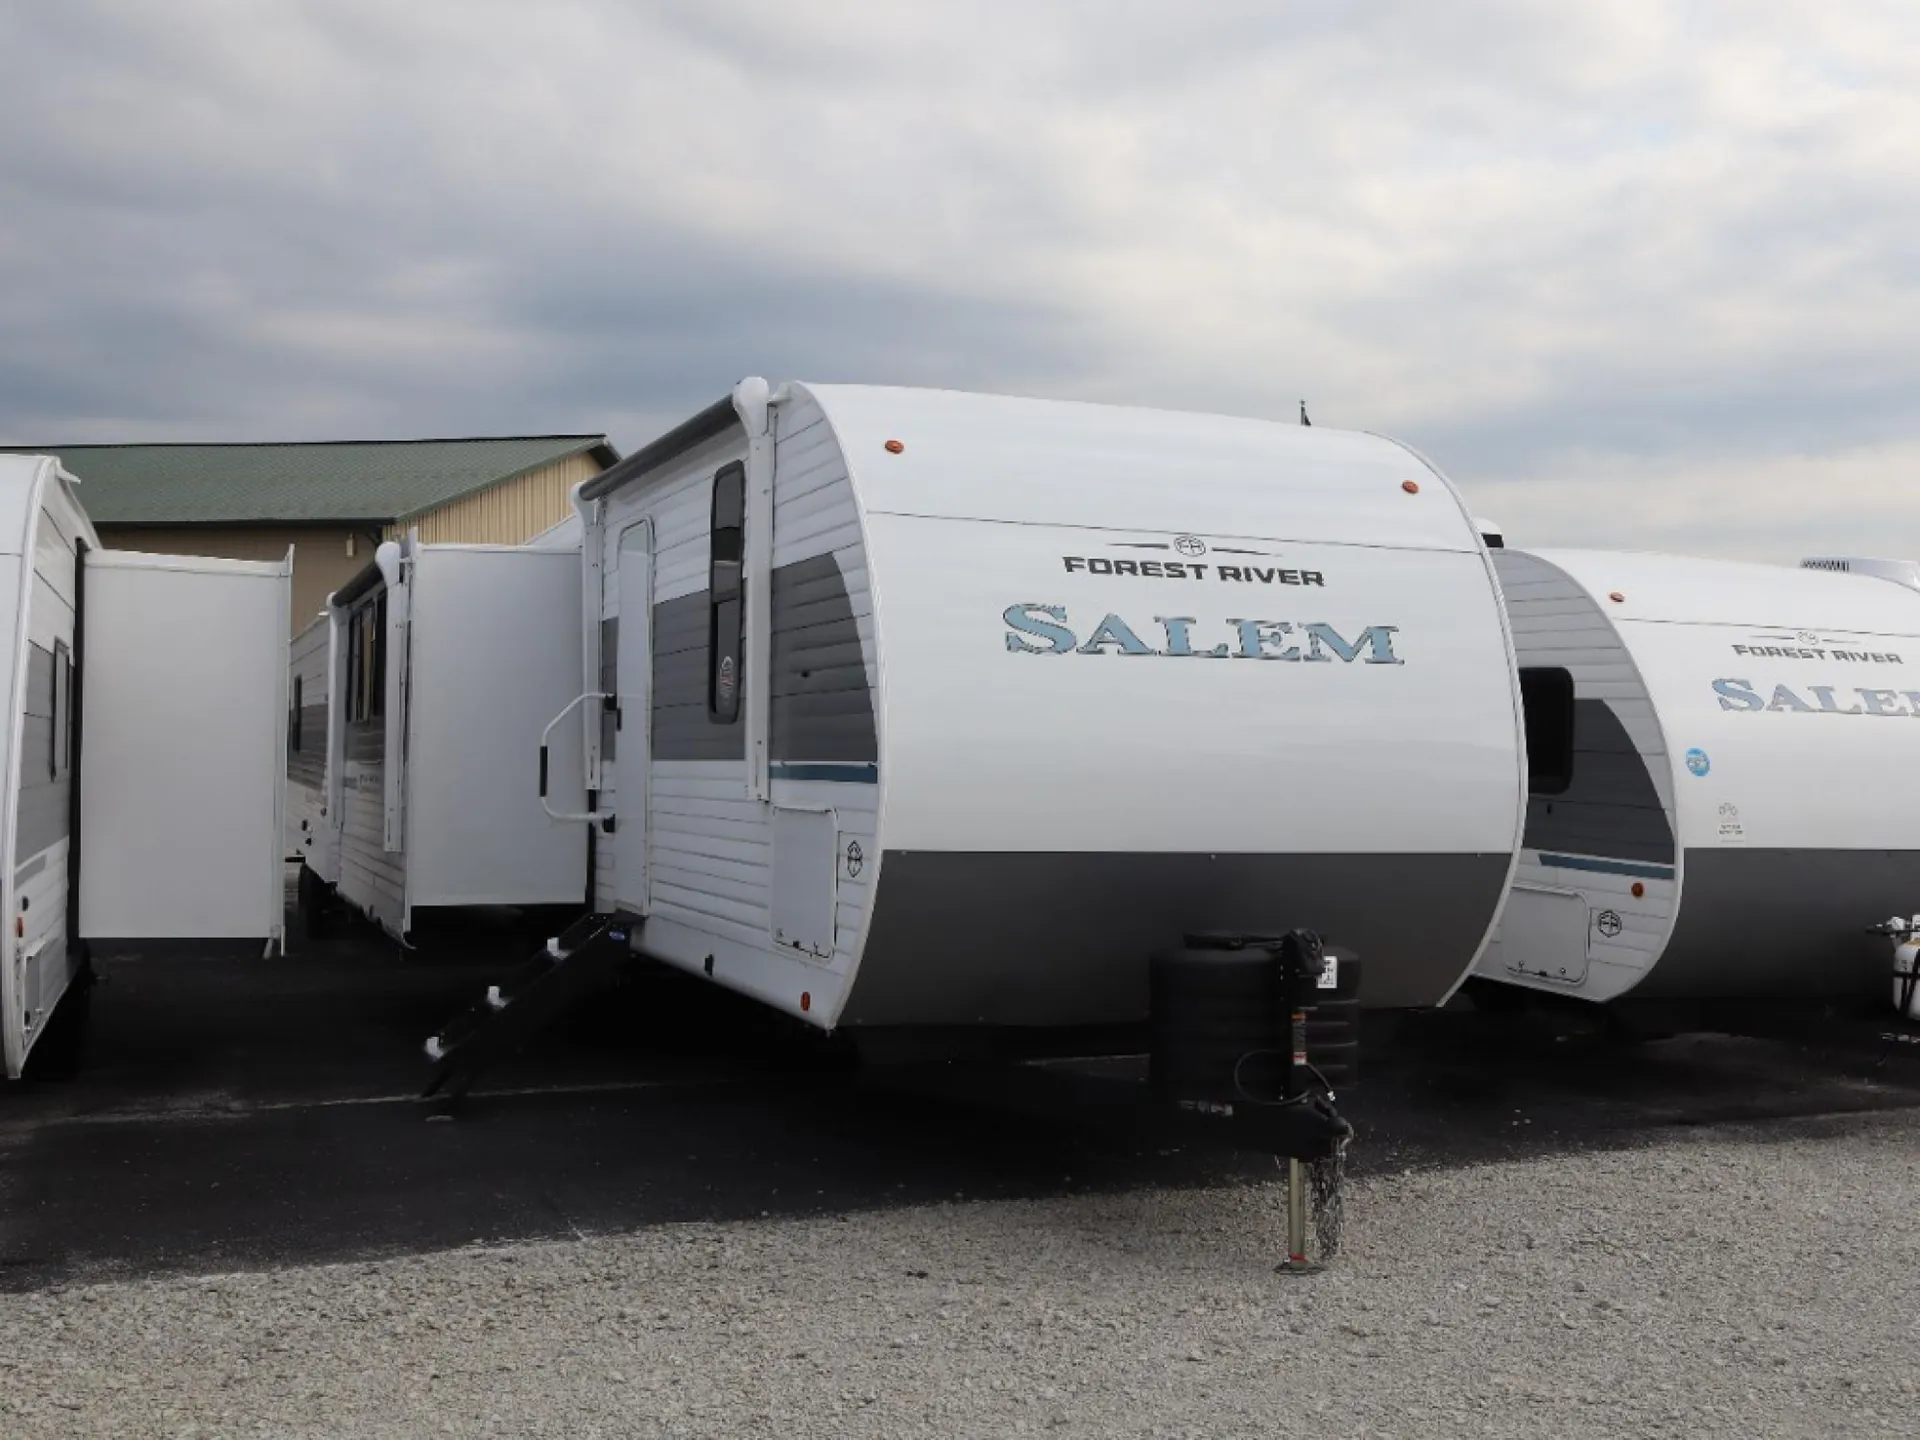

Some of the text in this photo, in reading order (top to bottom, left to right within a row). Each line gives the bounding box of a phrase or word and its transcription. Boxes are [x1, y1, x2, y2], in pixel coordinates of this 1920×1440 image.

[1062, 556, 1326, 587] FOREST RIVER
[1002, 602, 1405, 666] SALEM
[1731, 644, 1904, 665] FOREST RIVER
